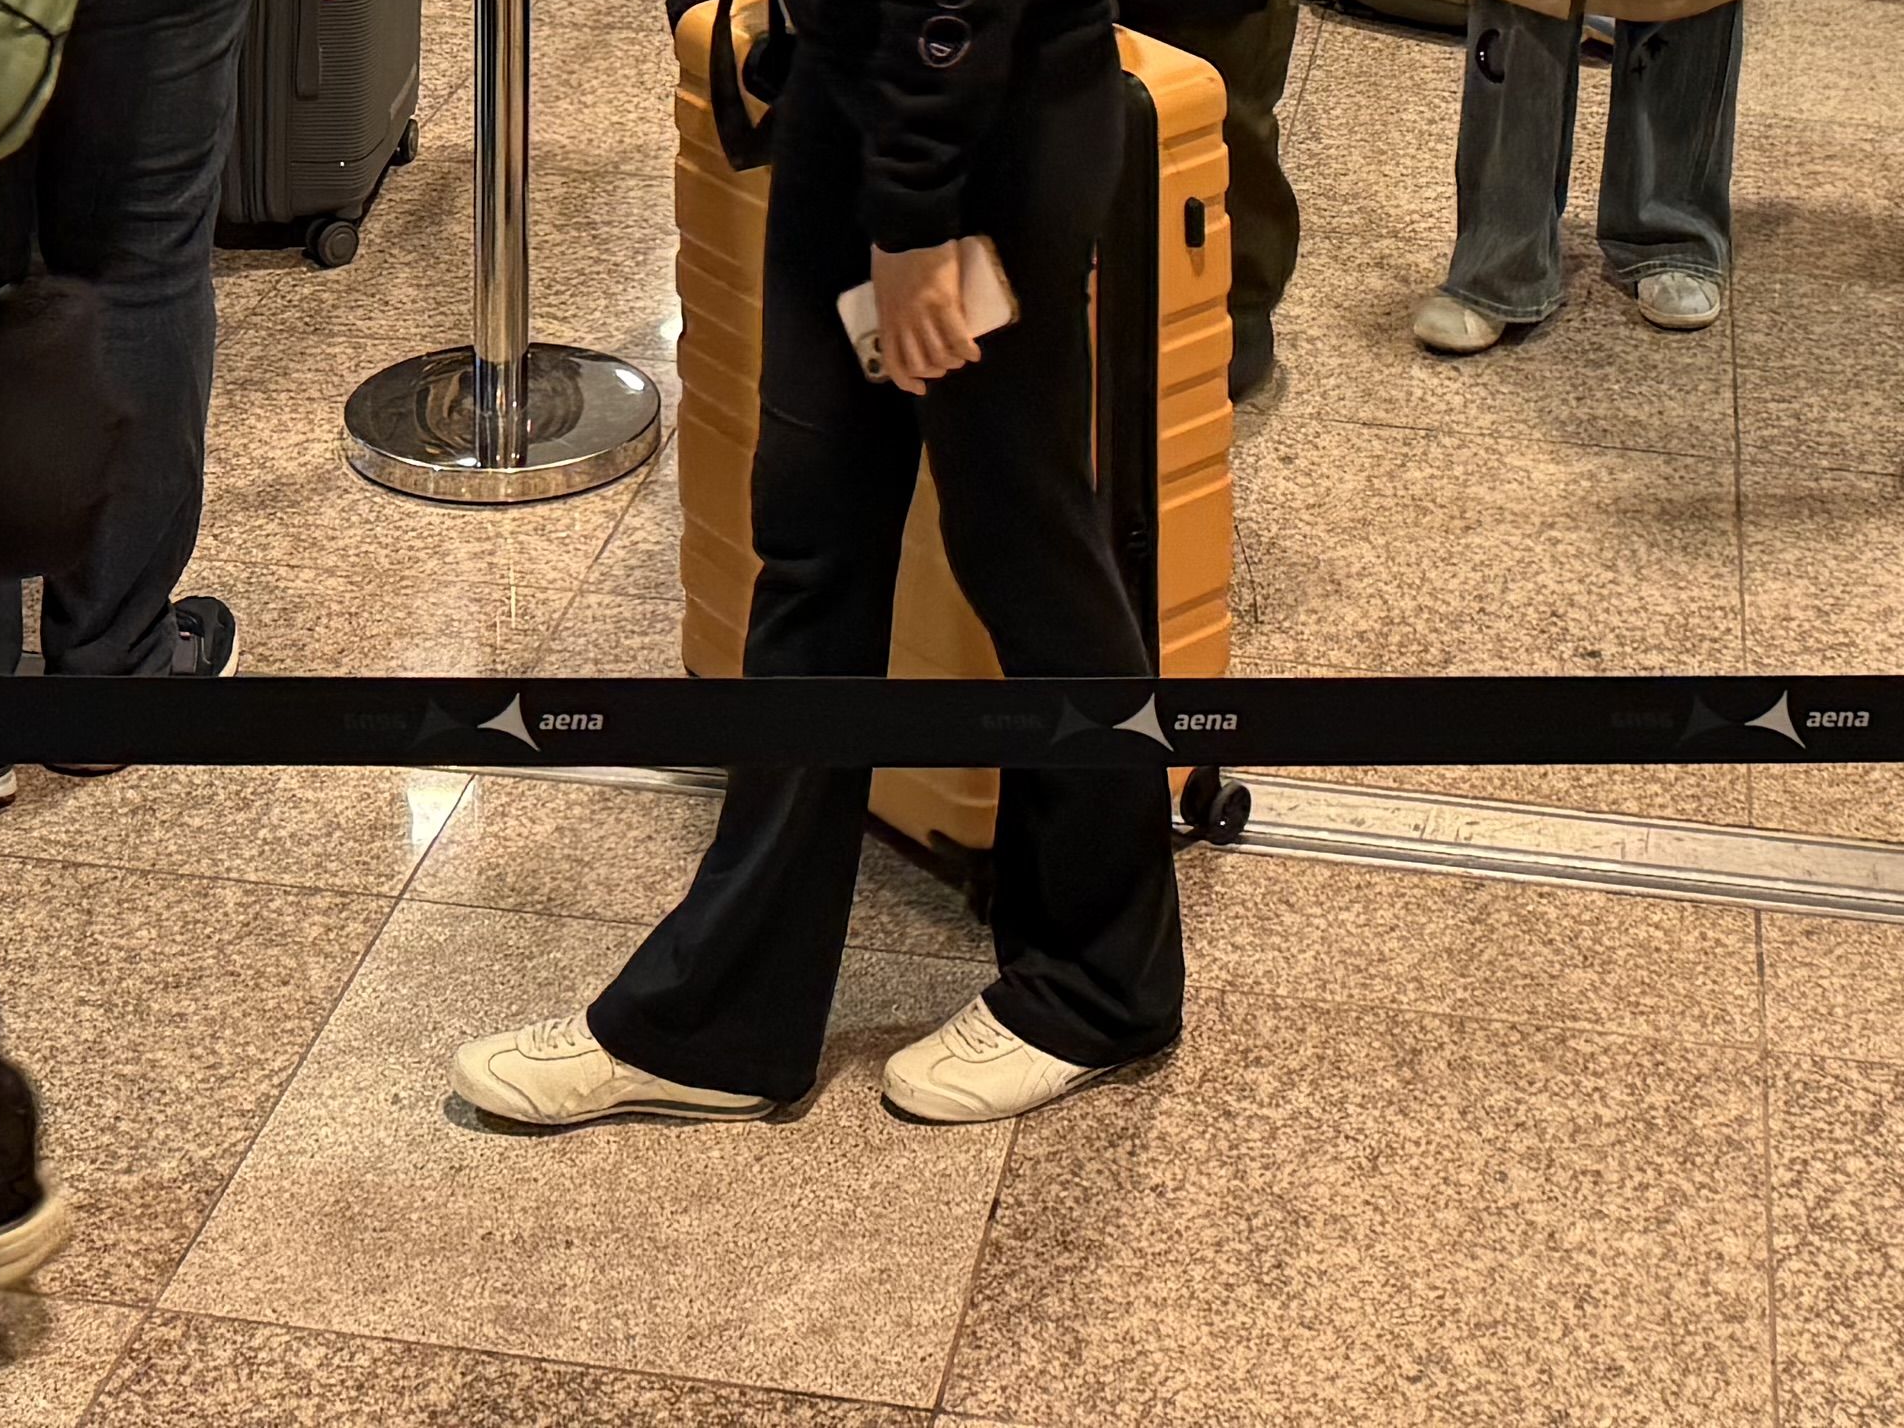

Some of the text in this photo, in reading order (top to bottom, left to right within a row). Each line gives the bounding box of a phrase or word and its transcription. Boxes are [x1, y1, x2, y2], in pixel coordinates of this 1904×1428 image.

[539, 710, 604, 732] aena
[1173, 707, 1238, 734] aena
[1806, 704, 1871, 731] aena
